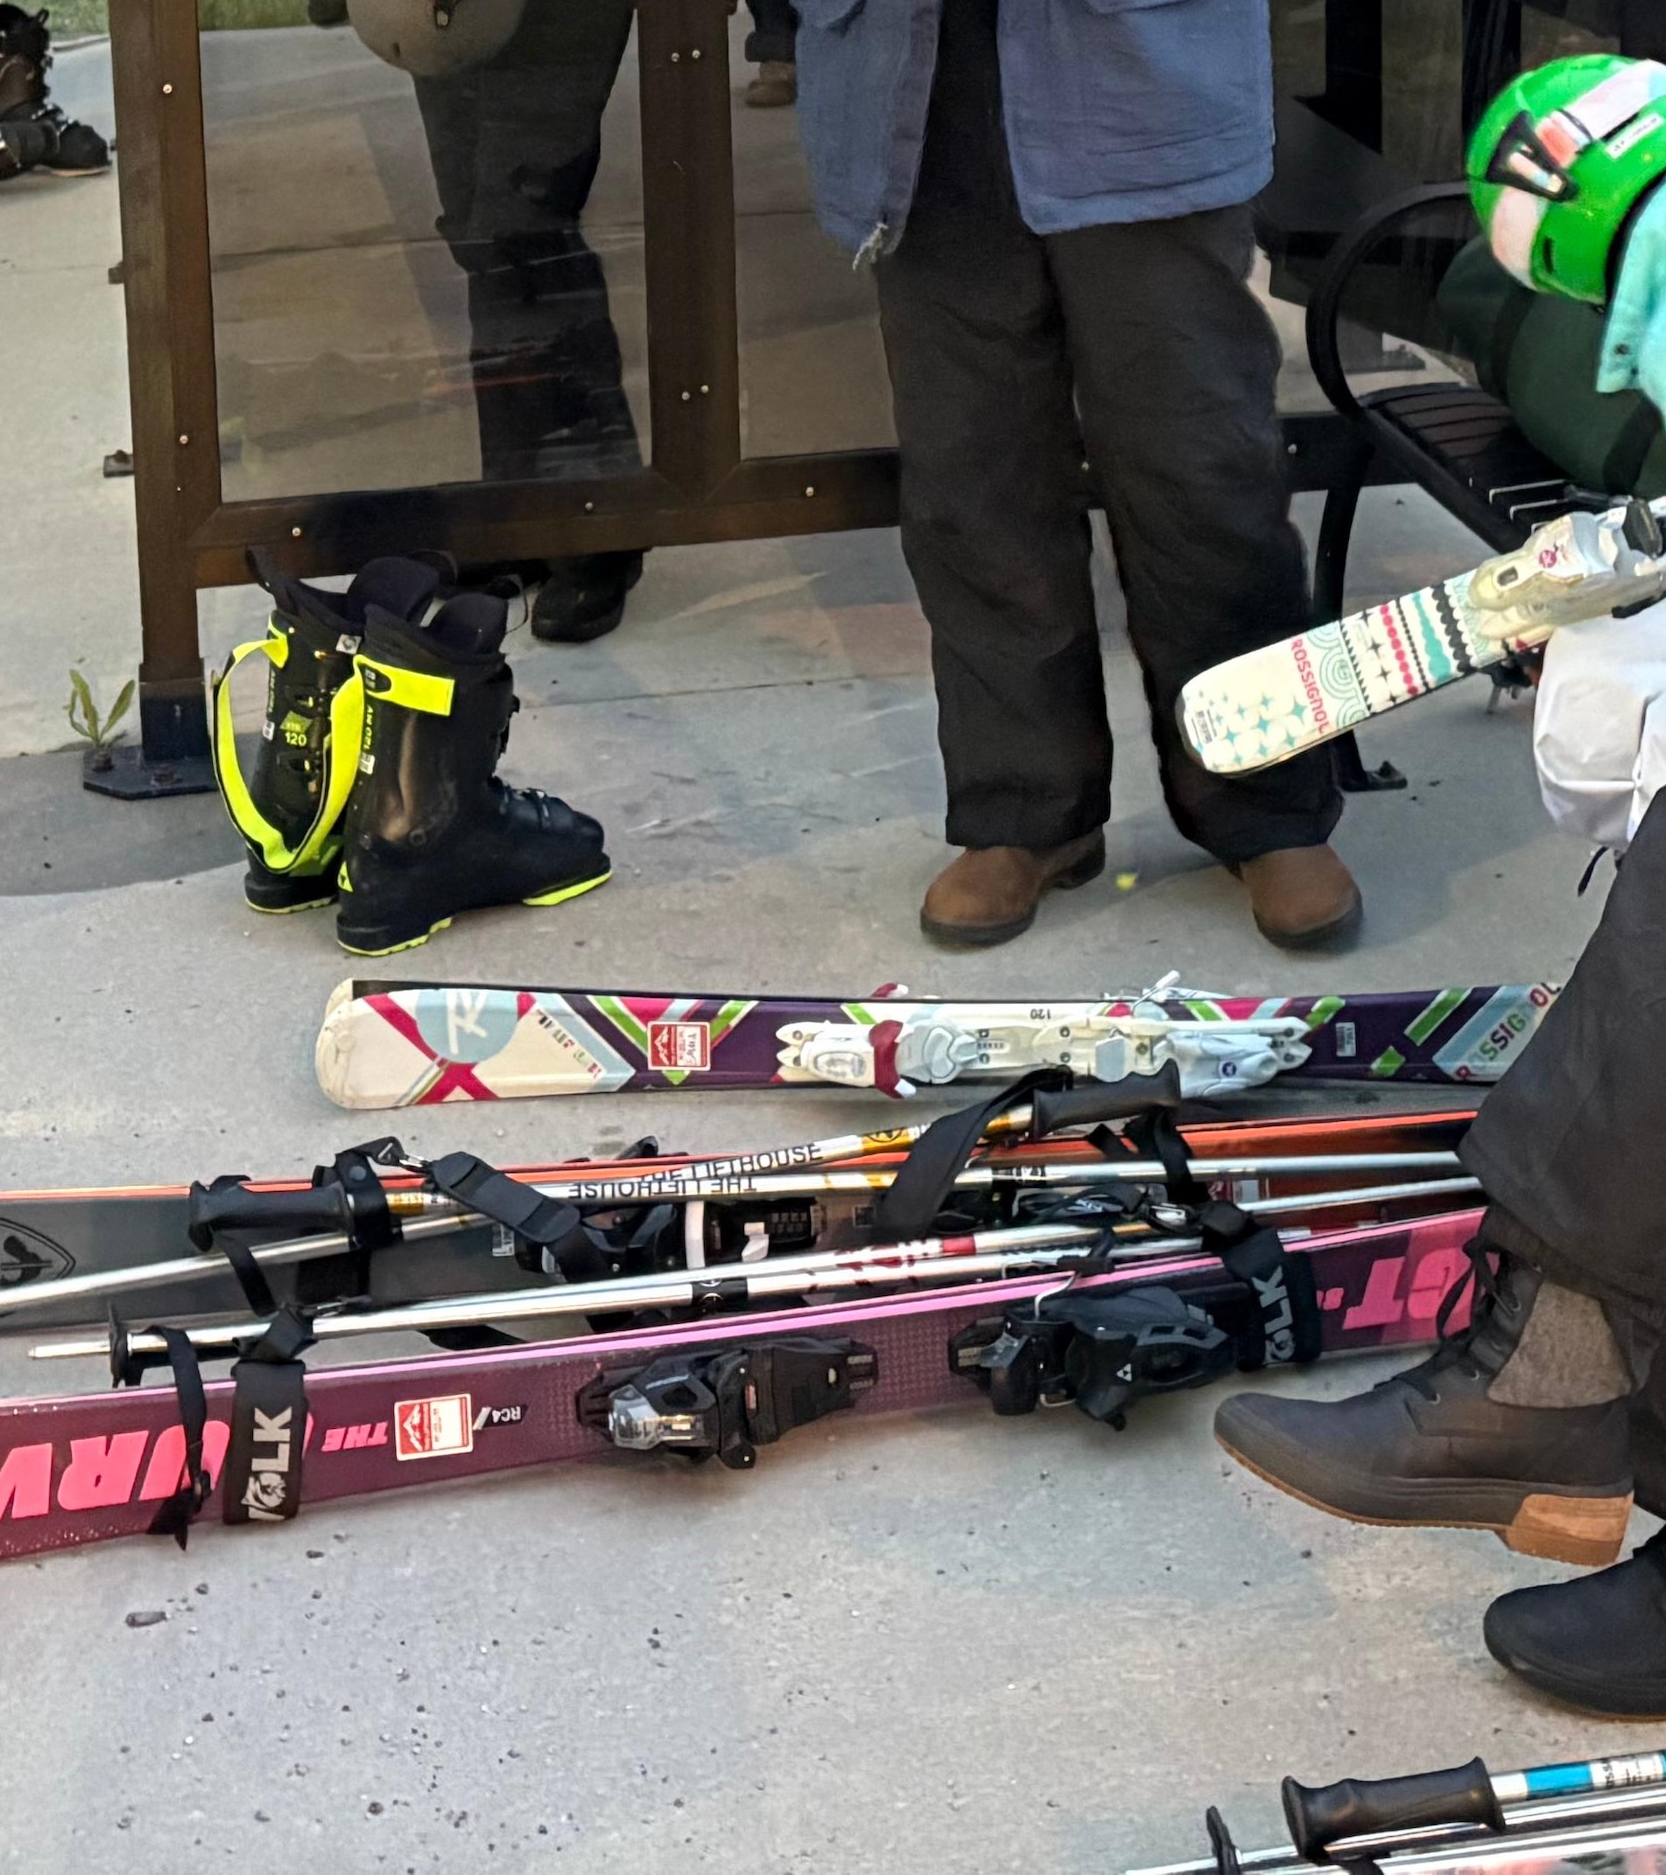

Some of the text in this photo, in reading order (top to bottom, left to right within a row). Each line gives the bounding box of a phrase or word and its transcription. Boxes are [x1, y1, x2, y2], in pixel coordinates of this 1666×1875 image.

[1290, 638, 1333, 734] ROSSIGNOL
[284, 731, 307, 747] 120
[492, 1406, 521, 1423] RC4
[321, 1421, 388, 1453] THE
